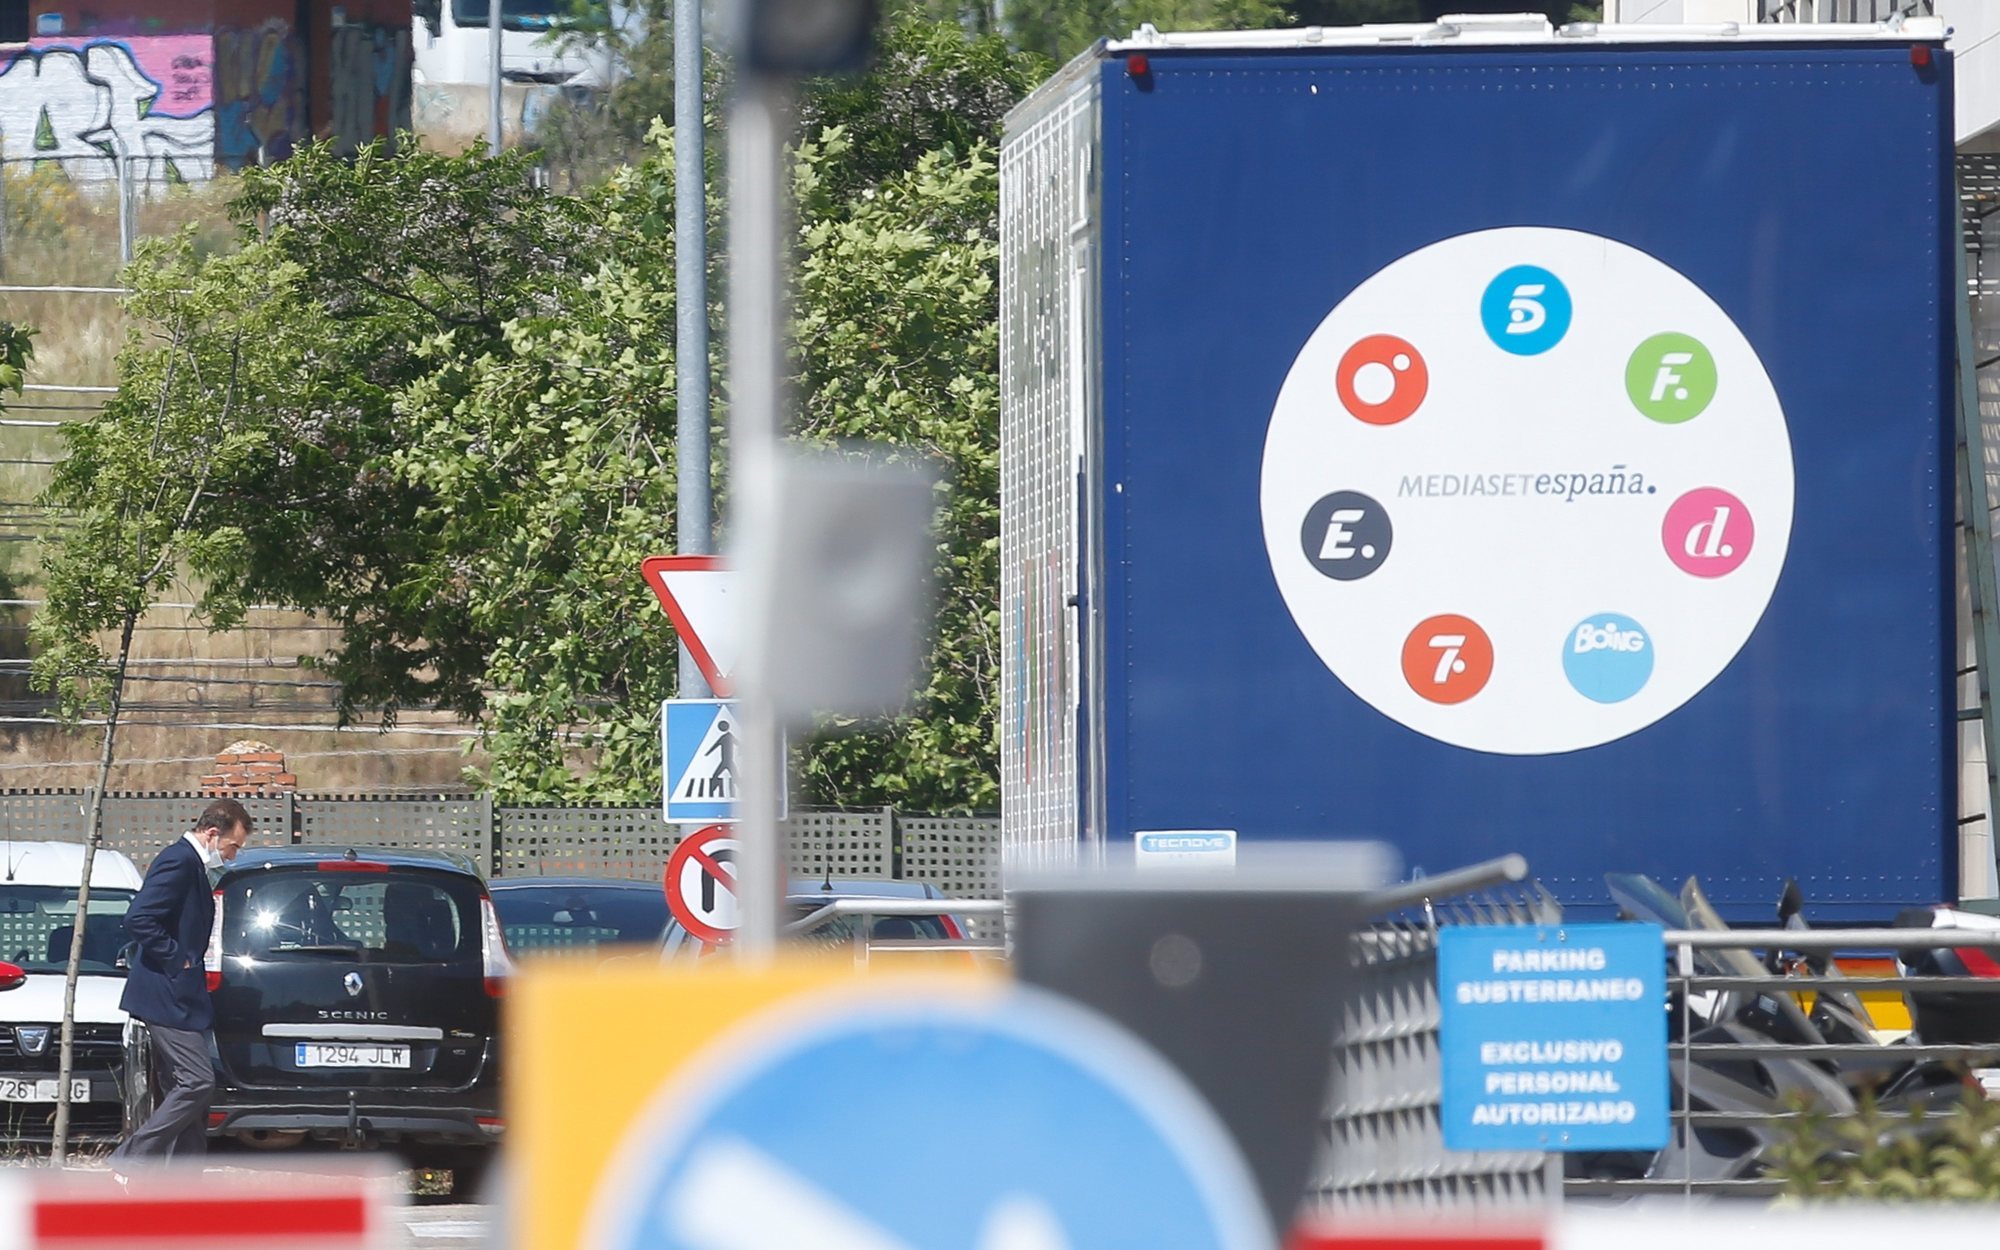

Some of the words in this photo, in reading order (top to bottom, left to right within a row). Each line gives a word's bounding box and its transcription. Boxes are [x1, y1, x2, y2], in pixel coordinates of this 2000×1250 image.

[1492, 948, 1606, 972] PARKING
[1457, 978, 1644, 1004] SUBTERRANEO
[318, 1010, 388, 1020] SCENIC
[316, 1046, 359, 1064] 1294
[1480, 1039, 1623, 1065] EXCLUSIVO
[51, 1081, 87, 1099] JG
[1485, 1070, 1621, 1094] PERSONAL
[1472, 1100, 1636, 1126] AUTORIZADO
